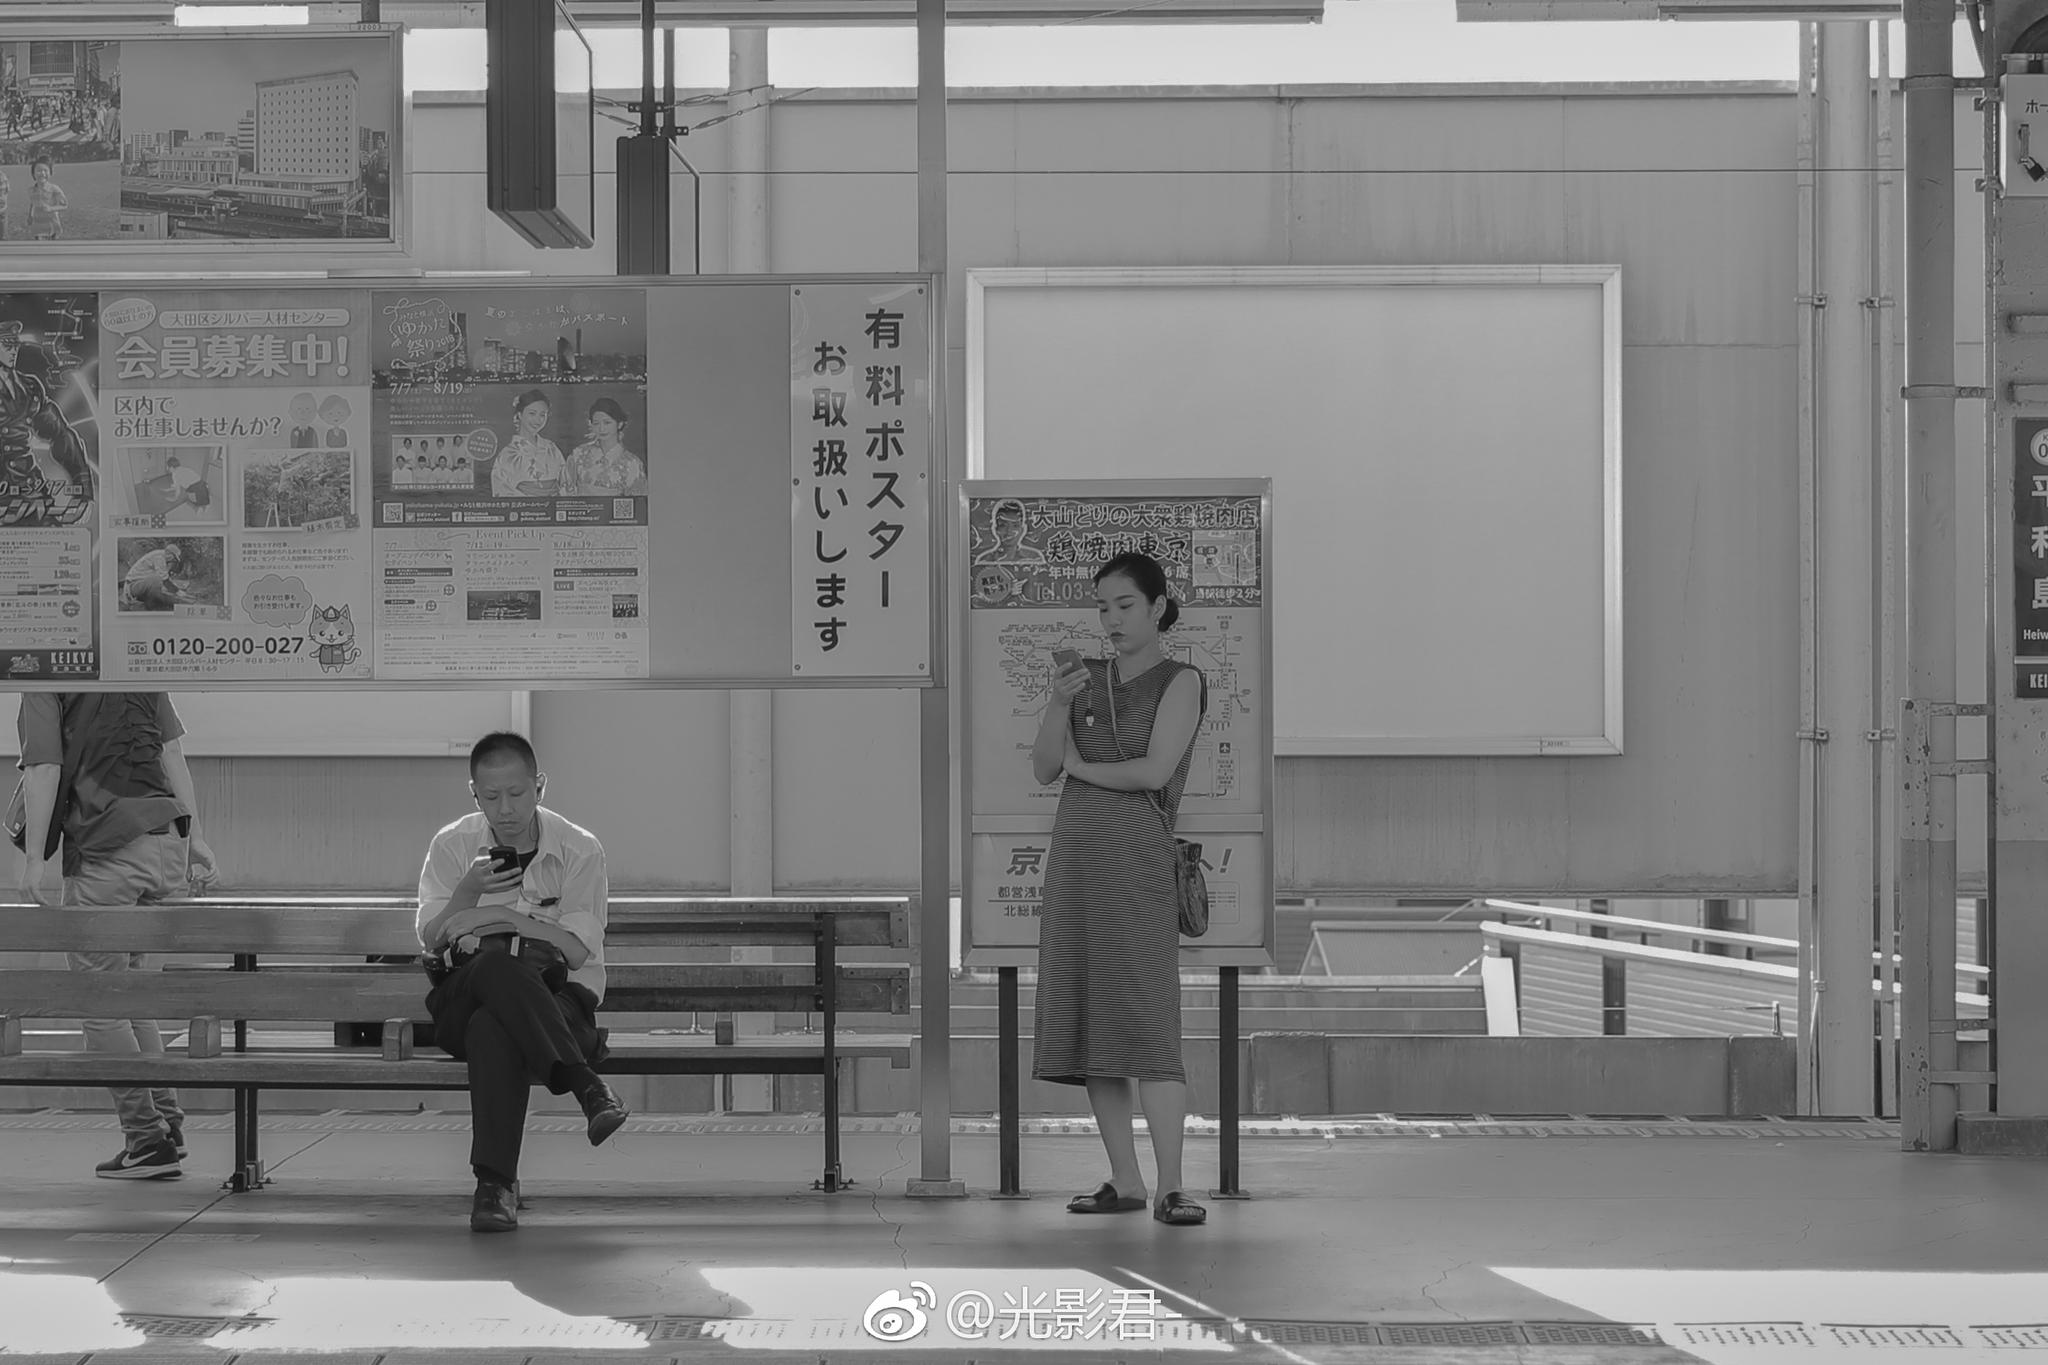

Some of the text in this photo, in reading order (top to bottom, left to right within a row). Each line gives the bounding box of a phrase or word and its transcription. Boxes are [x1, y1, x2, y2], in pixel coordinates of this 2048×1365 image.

[172, 312, 339, 328] 大田区シルバー人材センター
[397, 318, 447, 337] ゆかた
[114, 333, 350, 379] 会員募集中!
[115, 396, 177, 416] 区内で
[114, 416, 283, 438] お仕事しませんか?
[865, 308, 904, 607] 有料ポスター
[812, 341, 848, 652] お取扱いします
[1032, 504, 1257, 529] 大山どりの大衆鶏焼肉店
[476, 529, 506, 540] Event
[153, 637, 305, 657] 0120-200-027
[51, 652, 95, 664] KEIKYU
